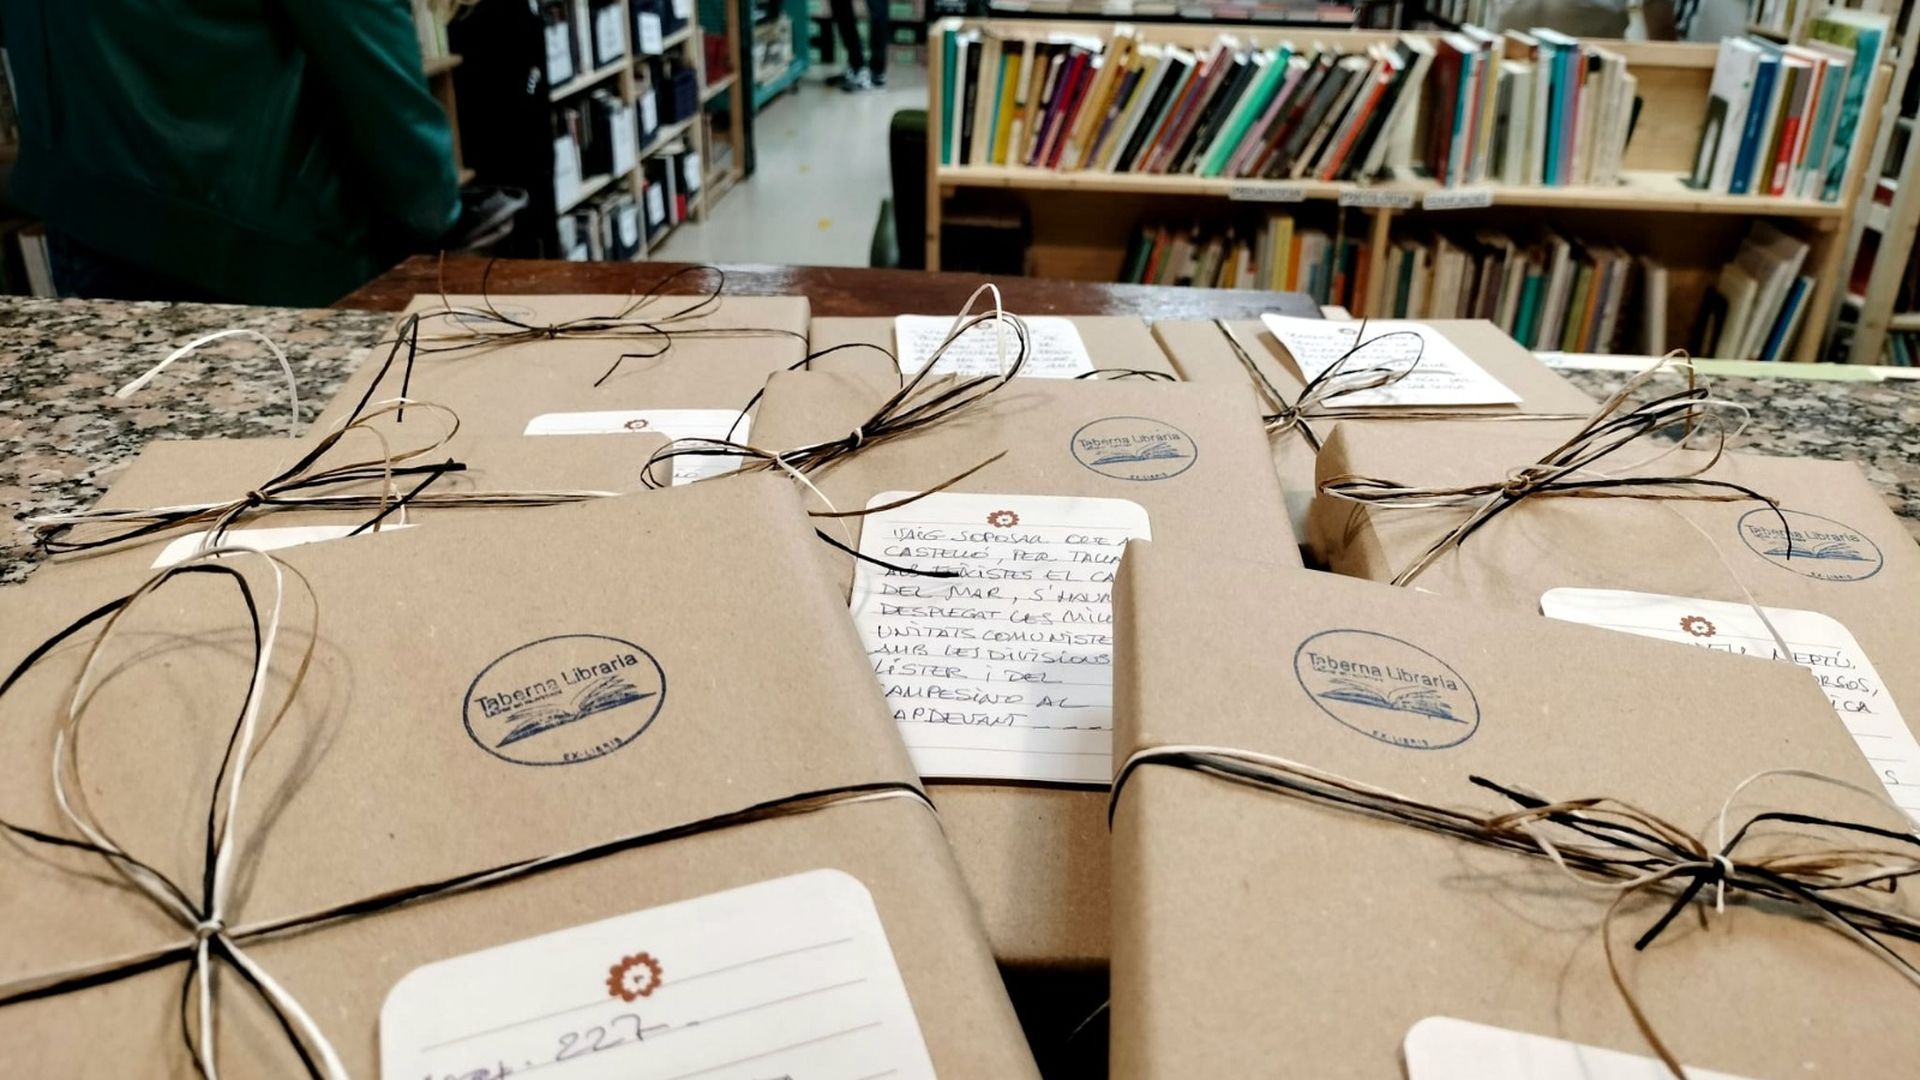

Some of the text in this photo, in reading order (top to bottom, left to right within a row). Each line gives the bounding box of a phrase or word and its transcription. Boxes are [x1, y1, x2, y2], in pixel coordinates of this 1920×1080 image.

[882, 583, 932, 598] DEL
[1003, 669, 1064, 684] DEL
[1306, 651, 1382, 678] Taberna
[1386, 666, 1459, 691] Libraria
[474, 678, 560, 714] Taberna
[560, 653, 639, 686] Libraria
[880, 683, 1024, 705] AMPESINO
